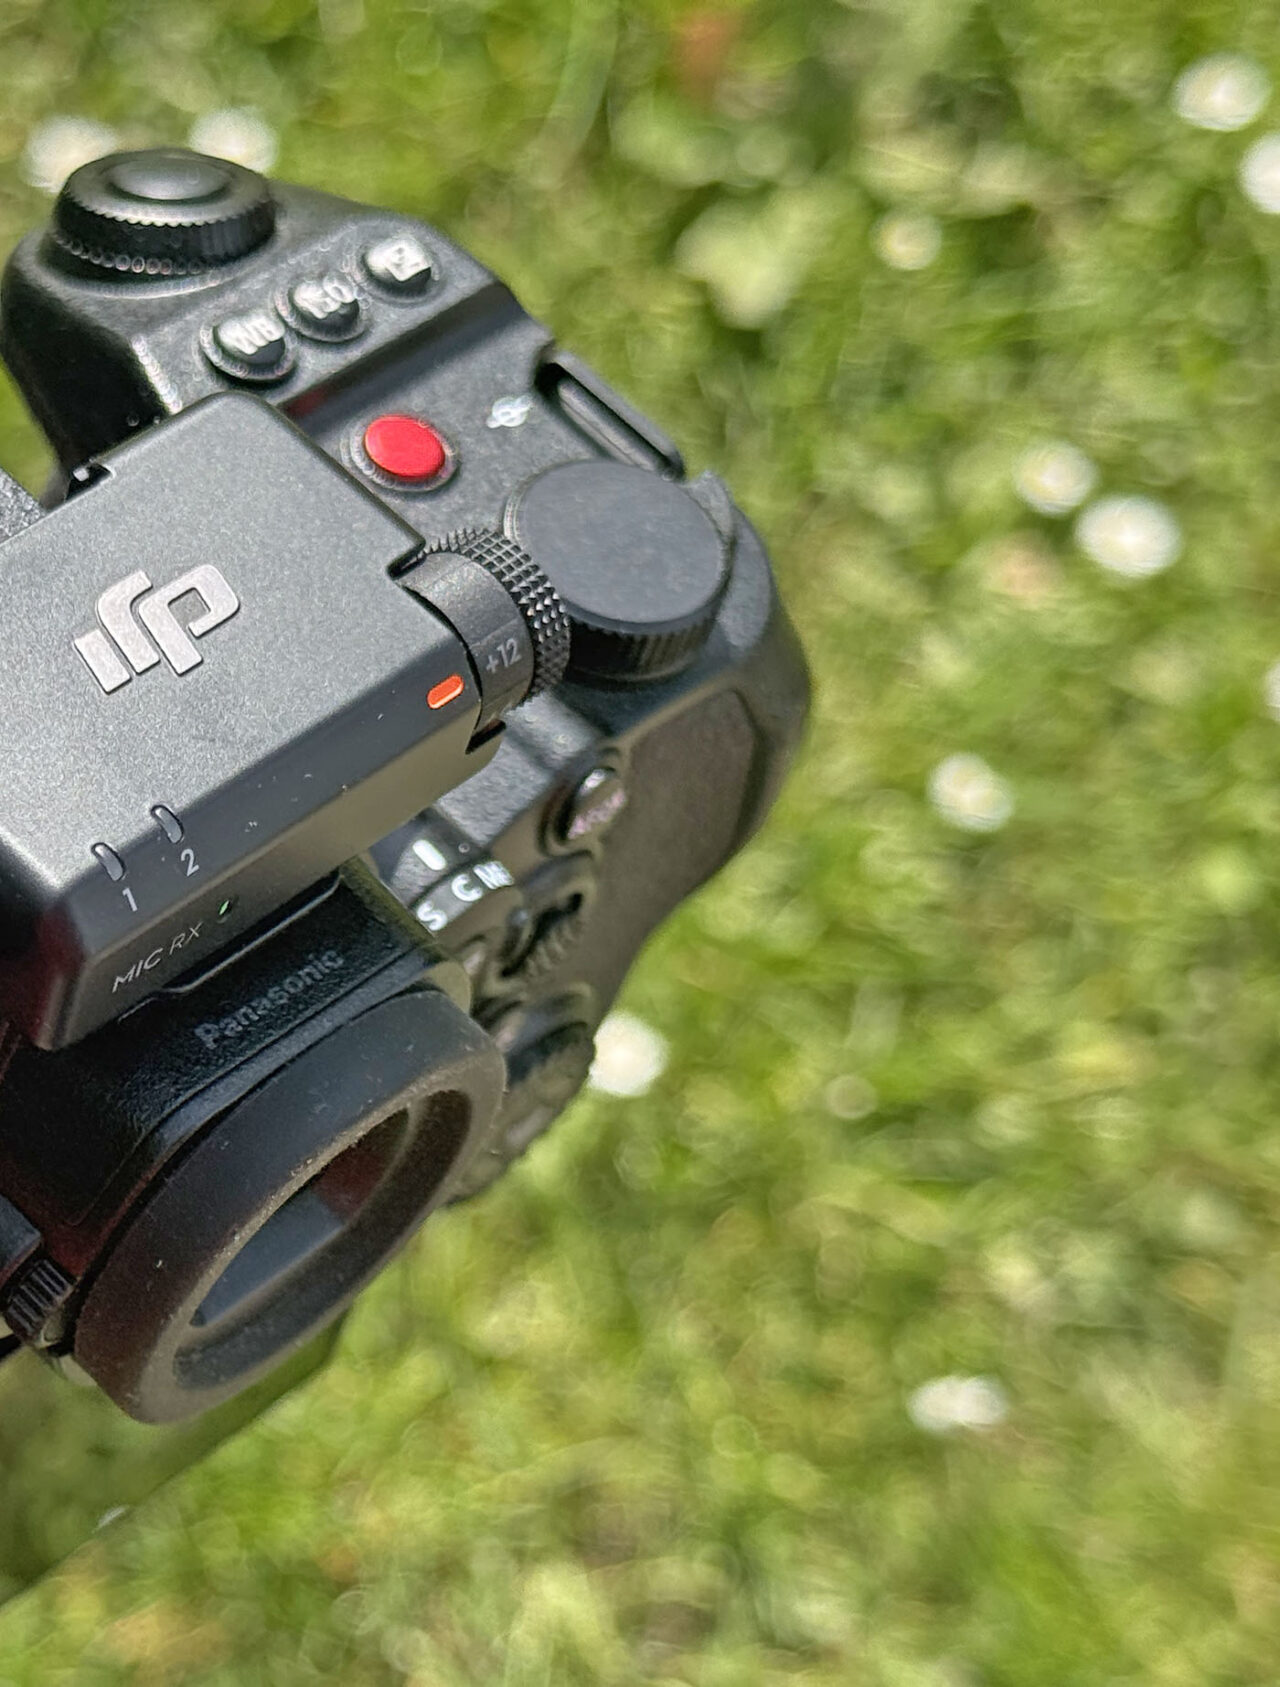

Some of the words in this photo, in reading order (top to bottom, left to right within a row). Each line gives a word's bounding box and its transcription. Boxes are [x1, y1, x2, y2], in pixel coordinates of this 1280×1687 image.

[486, 638, 522, 674] +12
[180, 848, 199, 876] 2
[122, 887, 137, 911] 1
[417, 900, 447, 931] S
[451, 873, 483, 902] C
[111, 948, 163, 992] MIC
[169, 922, 202, 956] RX
[195, 951, 343, 1049] Panasonic
